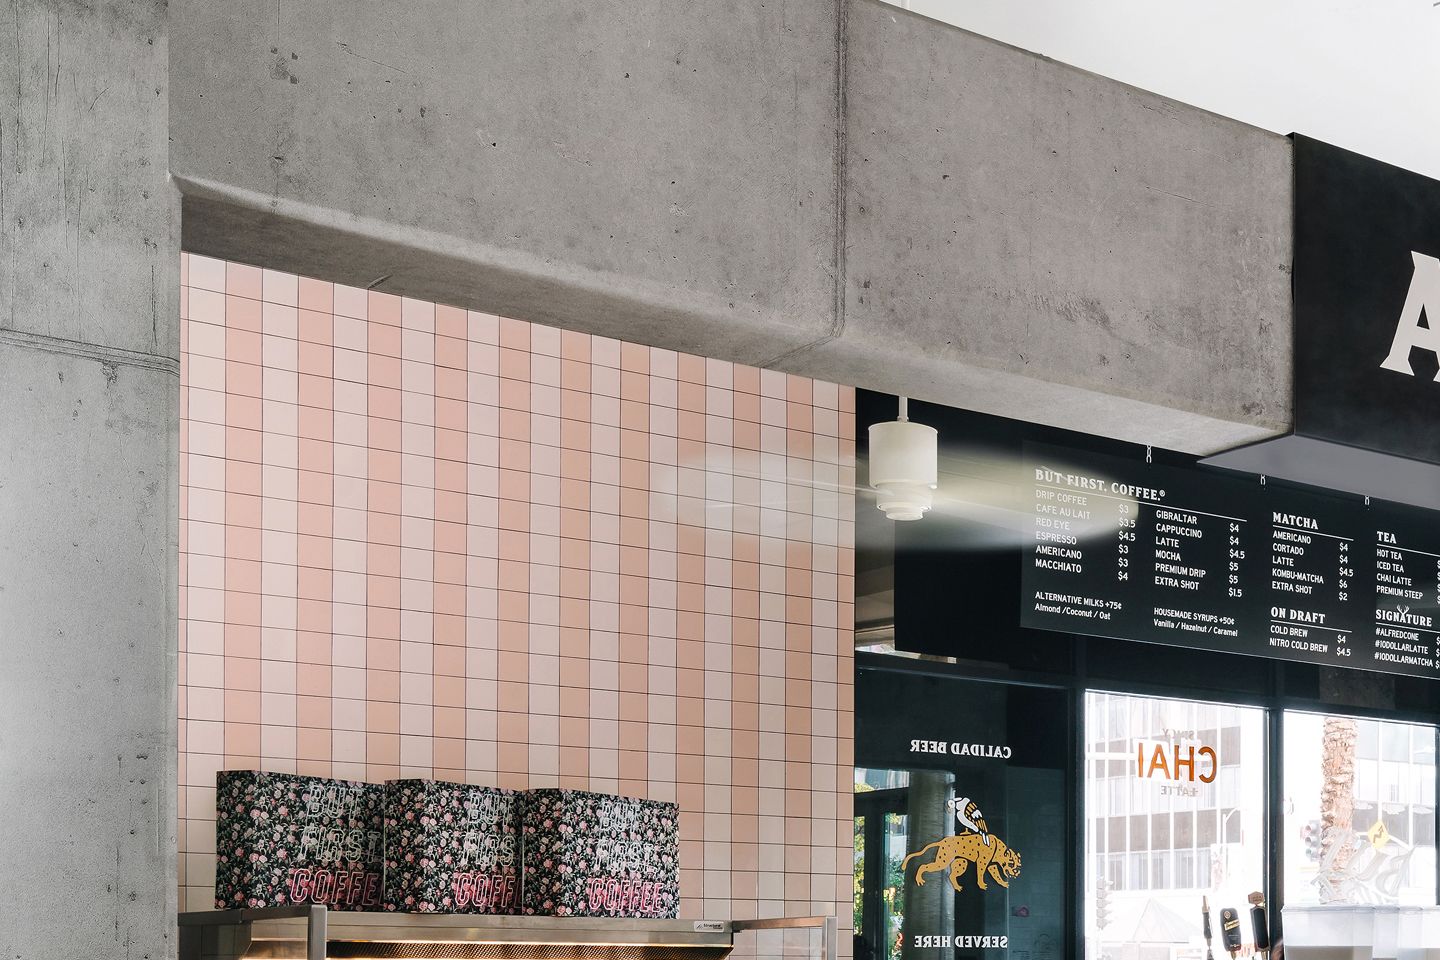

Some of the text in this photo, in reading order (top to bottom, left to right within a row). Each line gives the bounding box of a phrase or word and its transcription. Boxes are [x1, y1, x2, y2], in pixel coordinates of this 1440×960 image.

[1036, 469, 1062, 483] BUT
[1036, 489, 1129, 513] DRIP COFFEE $3
[1036, 504, 1136, 527] CAFE AU LAIT $3.5
[1156, 510, 1239, 533] GIBRALTAR $4
[1272, 512, 1318, 530] MATCHA
[1036, 518, 1136, 541] RED EYE $4.5
[1156, 523, 1239, 545] CAPPUCCINO $4
[1377, 531, 1396, 544] TEA
[1036, 531, 1129, 554] ESPRESSO $3
[1155, 536, 1245, 559] LATTE $4.5
[1273, 530, 1348, 552] AMERICANO $4
[1036, 545, 1129, 567] AMERICANO $3
[1155, 550, 1239, 571] MOCHA $5
[1273, 543, 1348, 564] CORTADO $4
[1376, 549, 1389, 558] HOT
[1390, 551, 1402, 560] TEA
[1035, 559, 1128, 581] MACCHIATO $4
[1155, 563, 1238, 584] PREMIUM DRIP $5
[1272, 555, 1353, 577] LATTE $4.5
[1376, 561, 1390, 571] ICED
[1392, 563, 1404, 573] TEA
[1155, 576, 1179, 588] EXTRA
[1180, 580, 1199, 591] SHOT
[1272, 568, 1347, 589] KOMBU-MATCHA $6
[1376, 573, 1392, 583] CHAI
[1393, 576, 1412, 586] LATTE
[1035, 591, 1082, 605] ALTERNATIVE
[1084, 598, 1103, 607] MILKS
[1272, 581, 1347, 601] EXTRA SHOT $2
[1376, 585, 1403, 596] PREMIUM
[1404, 589, 1423, 600] STEEP
[1035, 603, 1061, 613] Almond
[1100, 612, 1110, 620] Oat
[1154, 607, 1192, 619] HOUSEMADE
[1193, 613, 1218, 623] SYRUPS
[1271, 606, 1325, 624] ON DRAFT
[1376, 609, 1432, 627] SIGNATURE
[1154, 619, 1238, 636] Vanilla Hazelnut Caramel
[1270, 625, 1346, 644] COLD BREW $4
[1376, 628, 1419, 641] #ALFREDCONE
[1270, 637, 1351, 657] NITRO COLD BREW $4.5
